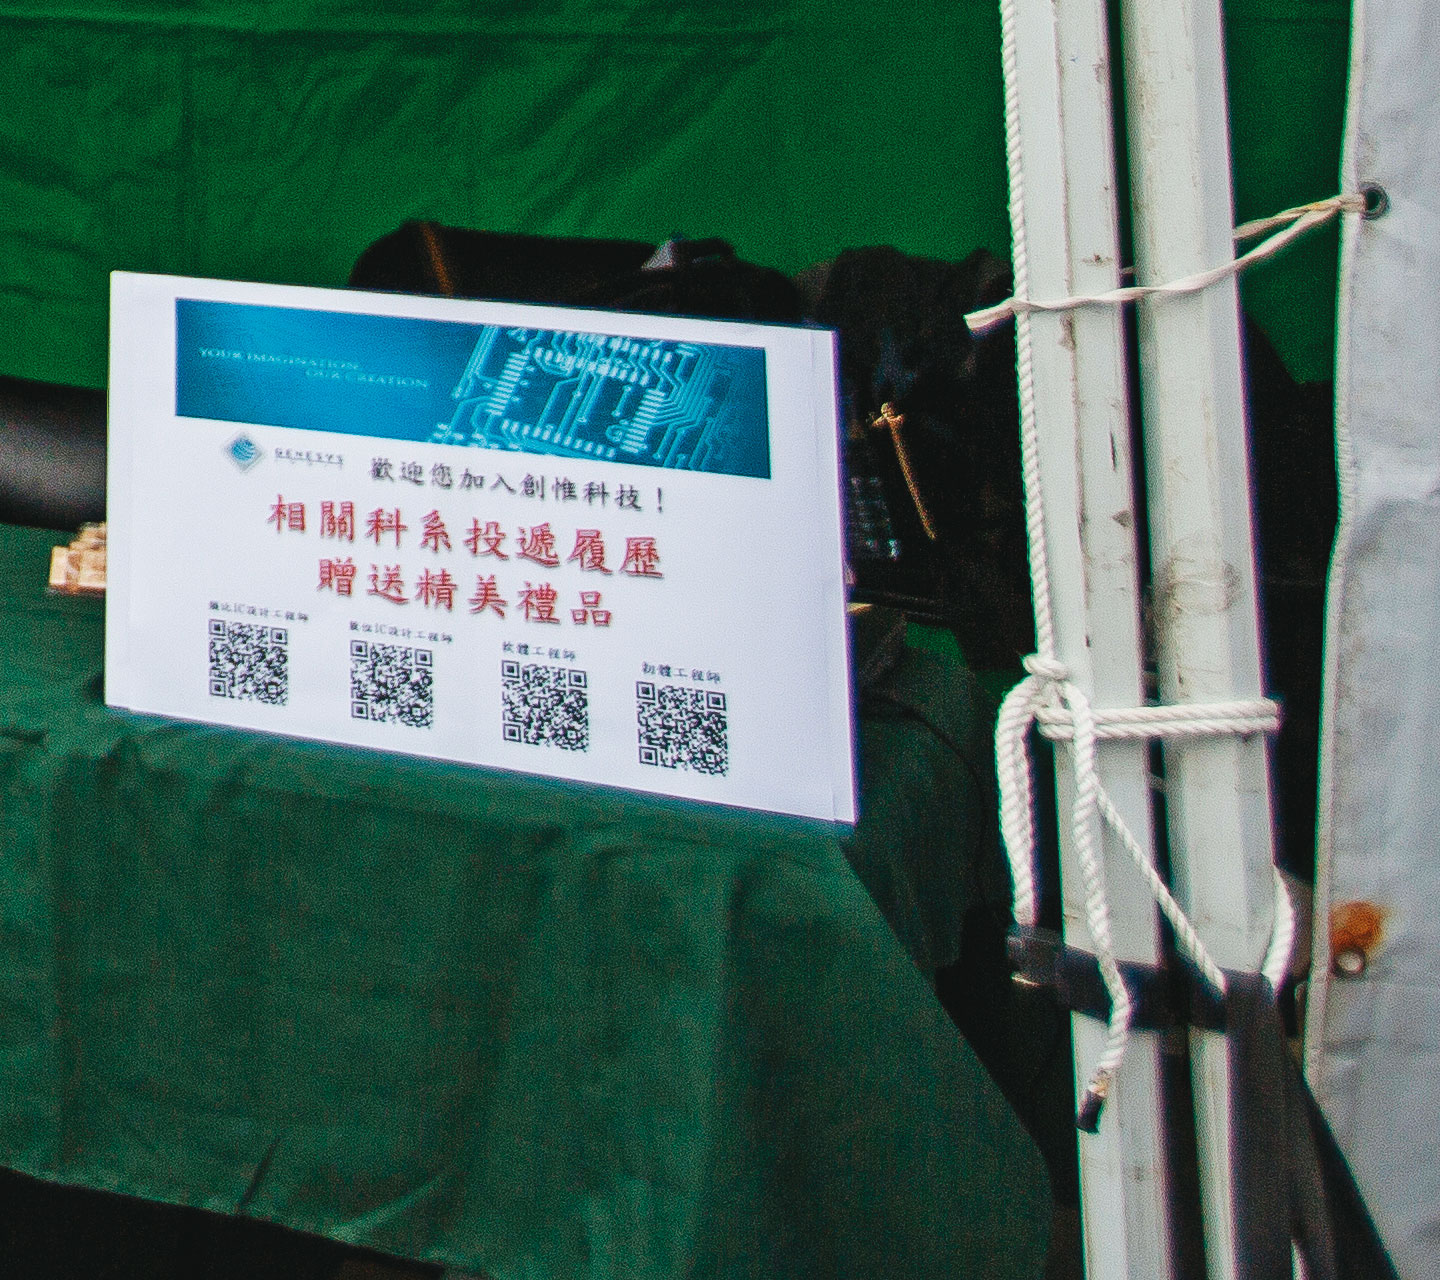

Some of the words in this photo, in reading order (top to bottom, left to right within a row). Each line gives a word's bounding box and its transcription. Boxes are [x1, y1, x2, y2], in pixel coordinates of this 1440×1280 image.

[266, 494, 665, 580] 相關科系投遞履歷
[316, 555, 615, 630] 贈送精美禮品
